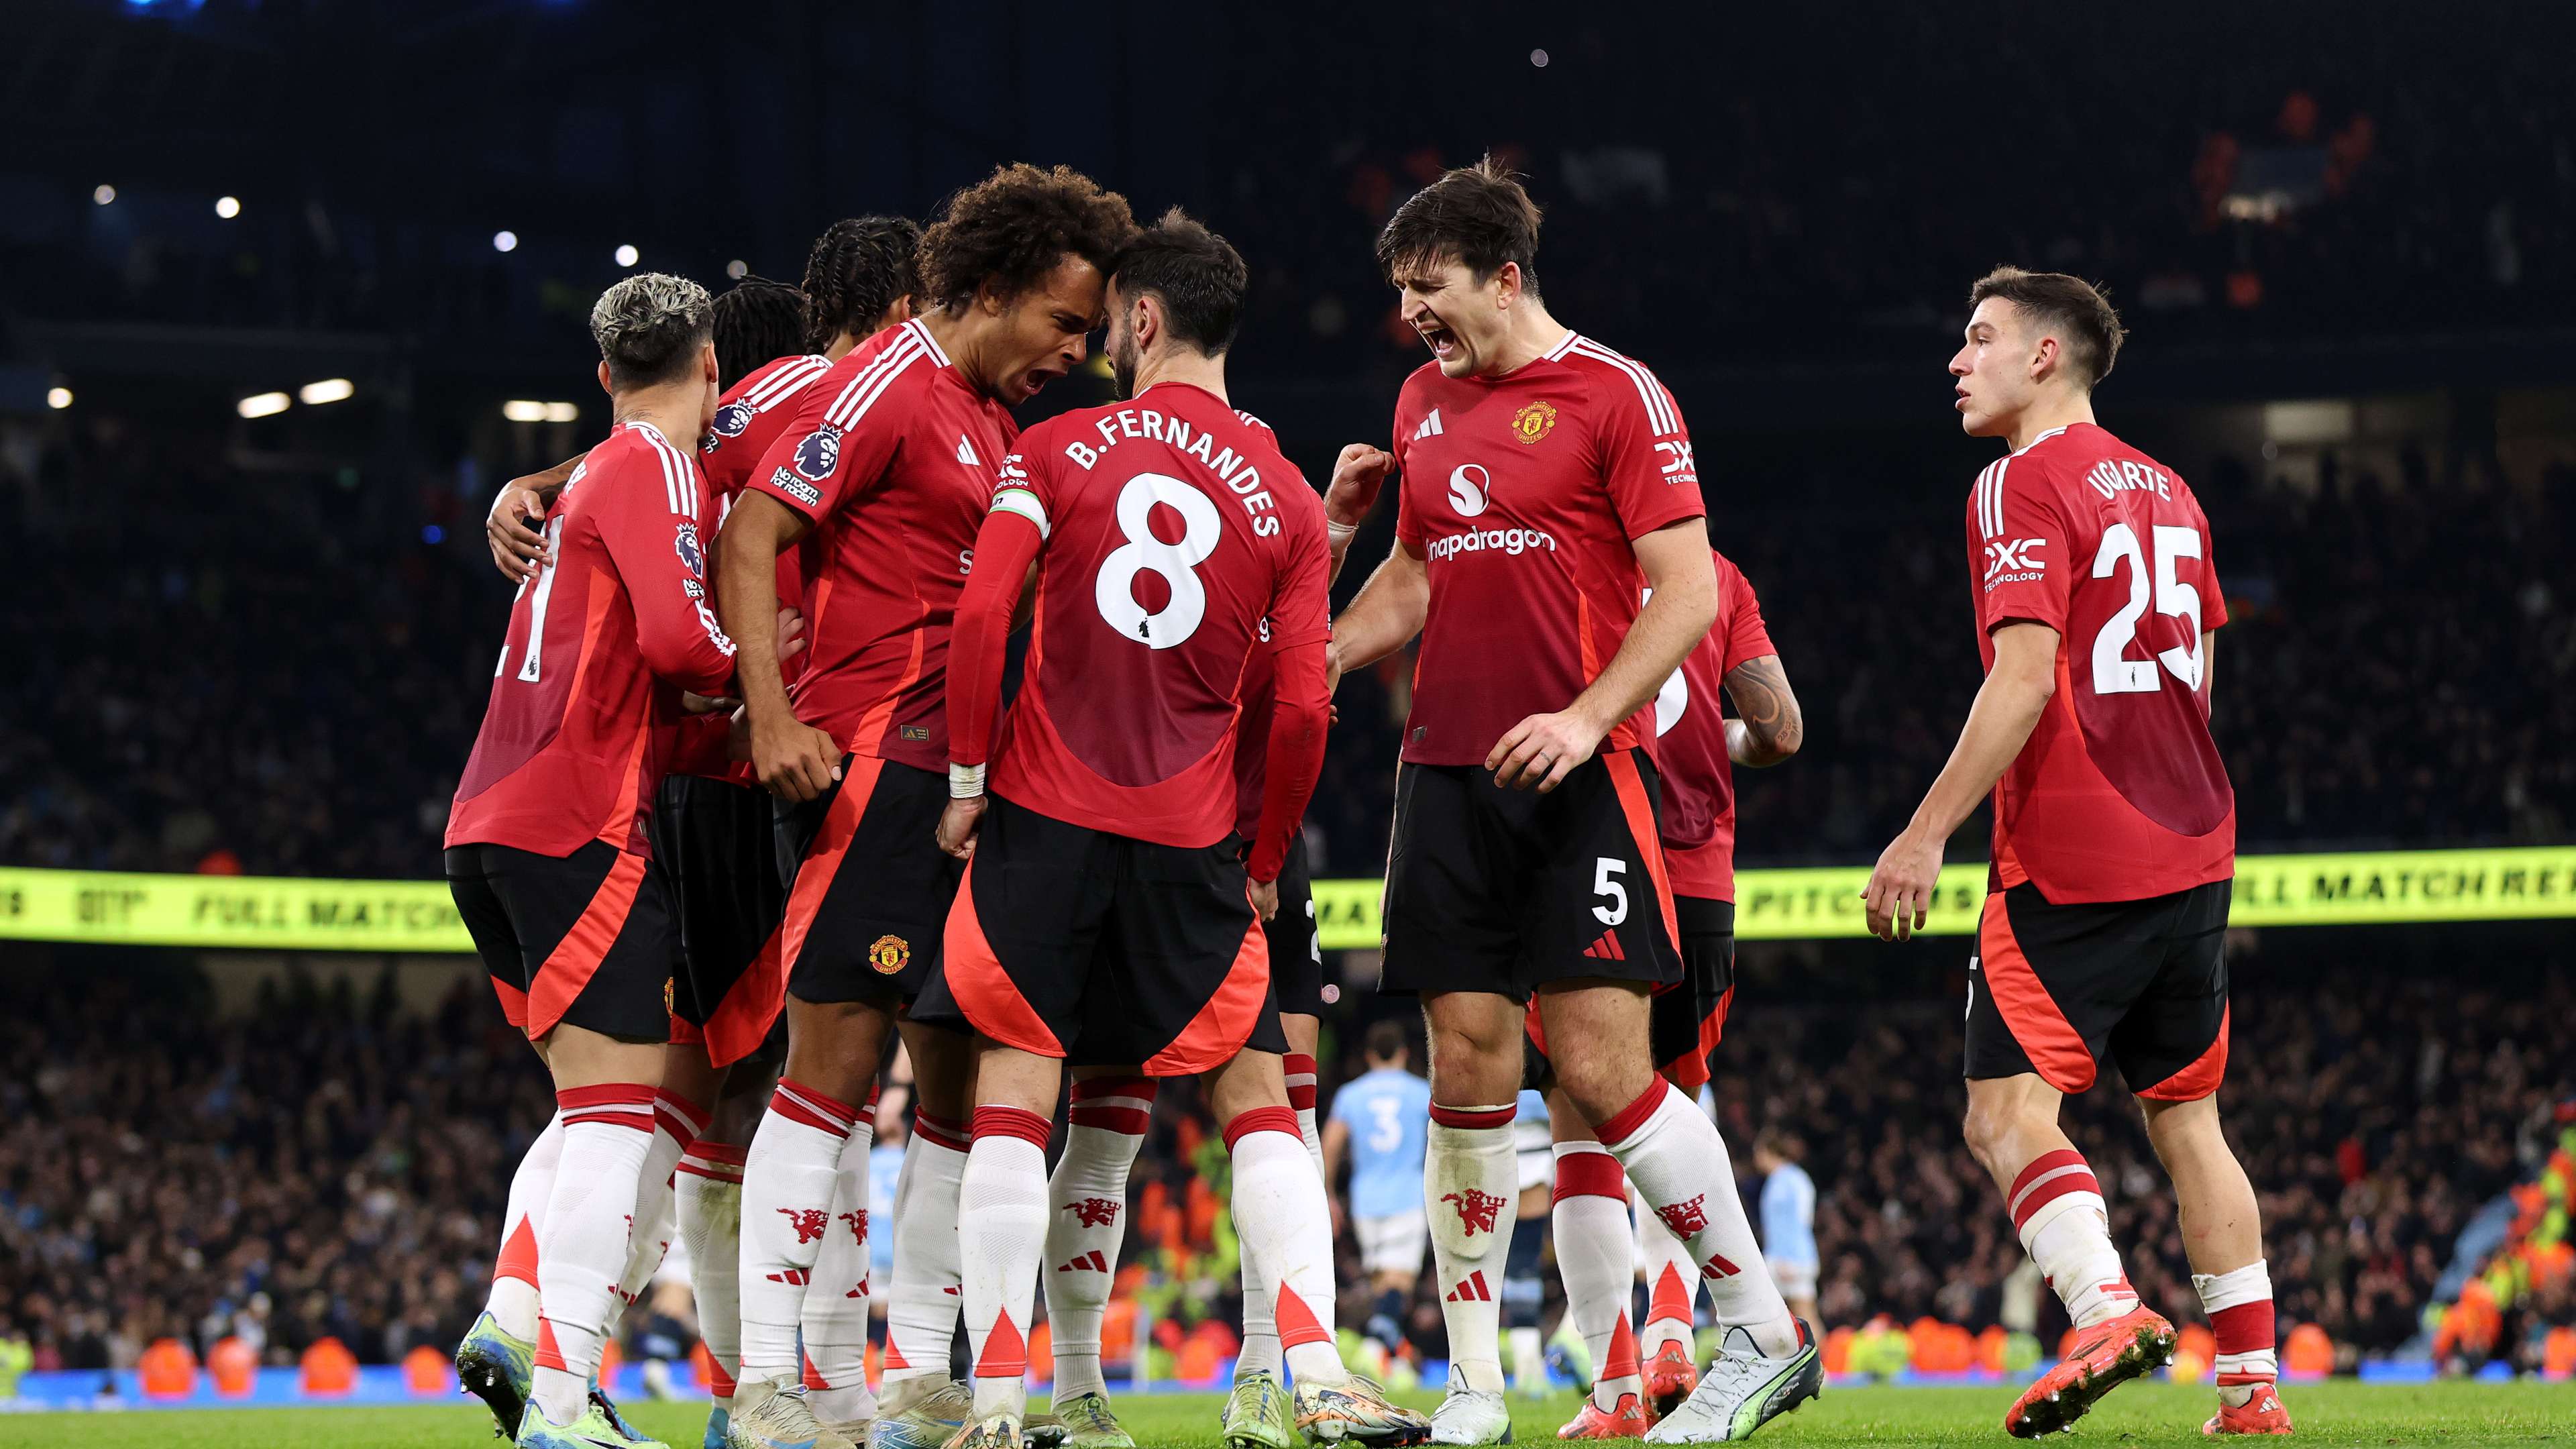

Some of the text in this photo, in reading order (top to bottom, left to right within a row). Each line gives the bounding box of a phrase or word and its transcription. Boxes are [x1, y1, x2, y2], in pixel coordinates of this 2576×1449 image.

[1518, 433, 1542, 442] UNITED
[1065, 409, 1280, 537] B.FERNANDES
[1654, 440, 1695, 474] DX
[769, 474, 818, 507] for racism
[773, 466, 818, 498] No room
[1664, 474, 1699, 486] TECHNO
[2087, 460, 2171, 502] UGARTE
[1095, 472, 1222, 650] 8
[1984, 572, 2045, 594] TECHNOLOGY
[2092, 522, 2205, 695] 25
[1591, 857, 1629, 926] 5
[2311, 867, 2486, 903] MATCH
[873, 938, 906, 952] MANCHESTER
[879, 963, 902, 973] UNITED
[1366, 1097, 1403, 1152] 3
